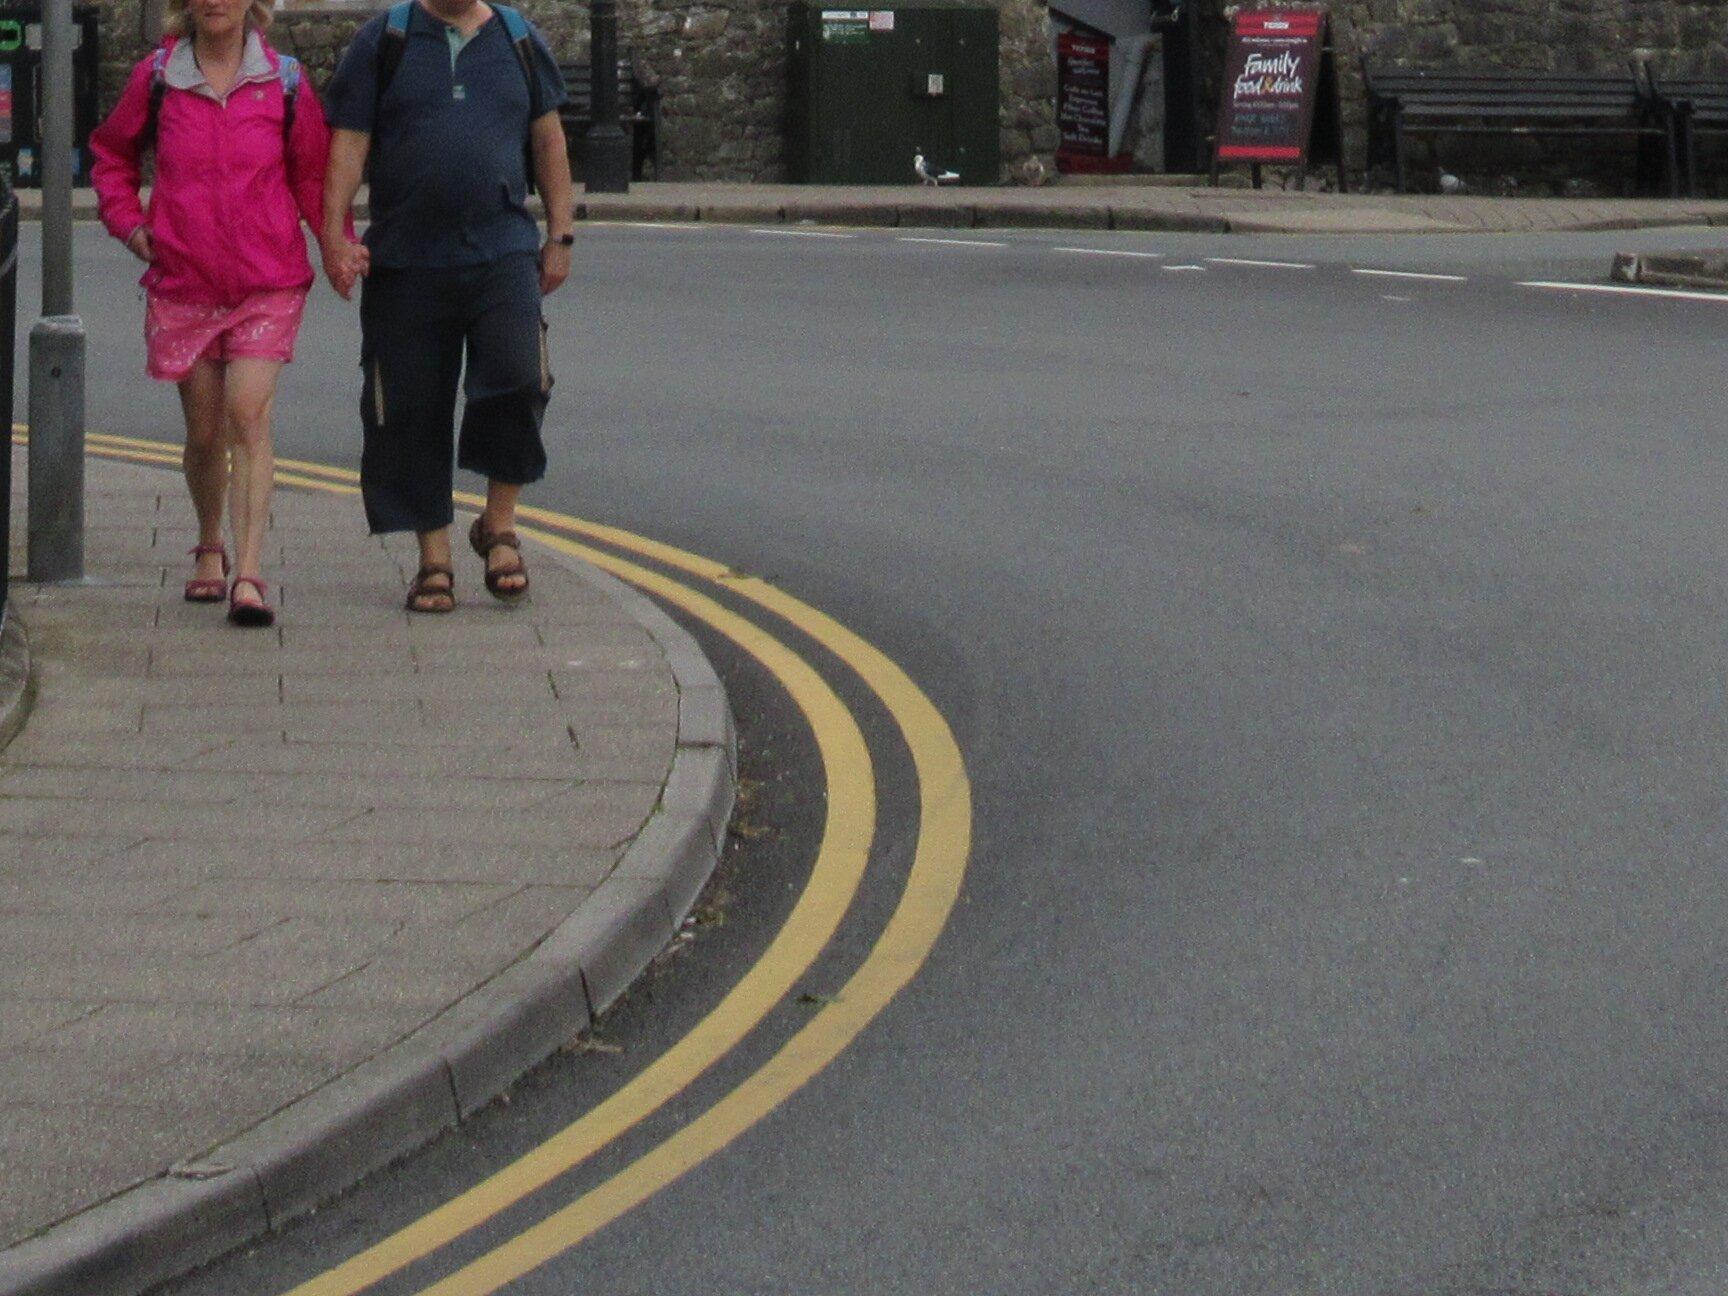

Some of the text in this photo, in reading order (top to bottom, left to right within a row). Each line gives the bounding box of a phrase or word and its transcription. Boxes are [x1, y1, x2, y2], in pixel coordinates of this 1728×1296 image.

[1244, 50, 1301, 79] Family
[1233, 74, 1265, 100] food
[1273, 74, 1303, 94] drink
